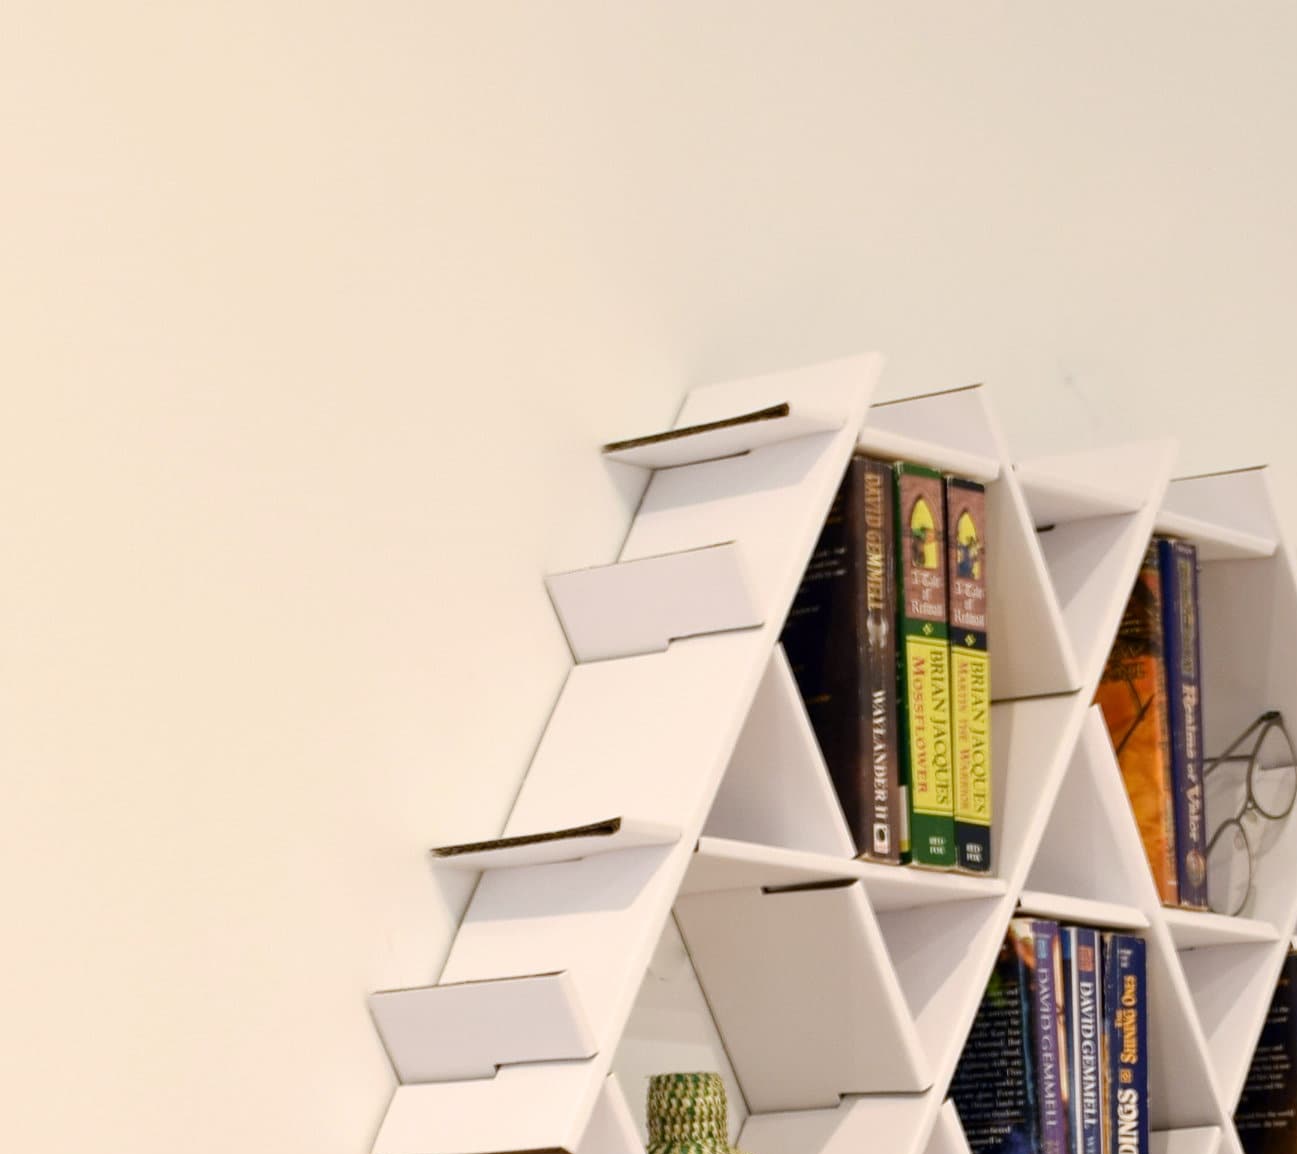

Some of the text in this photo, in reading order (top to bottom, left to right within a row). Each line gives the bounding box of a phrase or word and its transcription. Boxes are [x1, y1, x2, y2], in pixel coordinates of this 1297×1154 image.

[864, 473, 886, 610] DAVID GEMMELL
[872, 690, 889, 802] WAYLANDER
[911, 656, 928, 794] MOSSFLOWER
[930, 650, 950, 805] BRIAN JACQUES
[970, 661, 987, 814] BRIAN JACQUES
[1182, 684, 1201, 759] Realms
[1185, 785, 1202, 843] Valor
[1038, 967, 1054, 1031] DAVID
[1079, 980, 1096, 1039] DAVID
[1042, 1035, 1057, 1130] GEMMELL
[1082, 1039, 1099, 1129] GEMMELL
